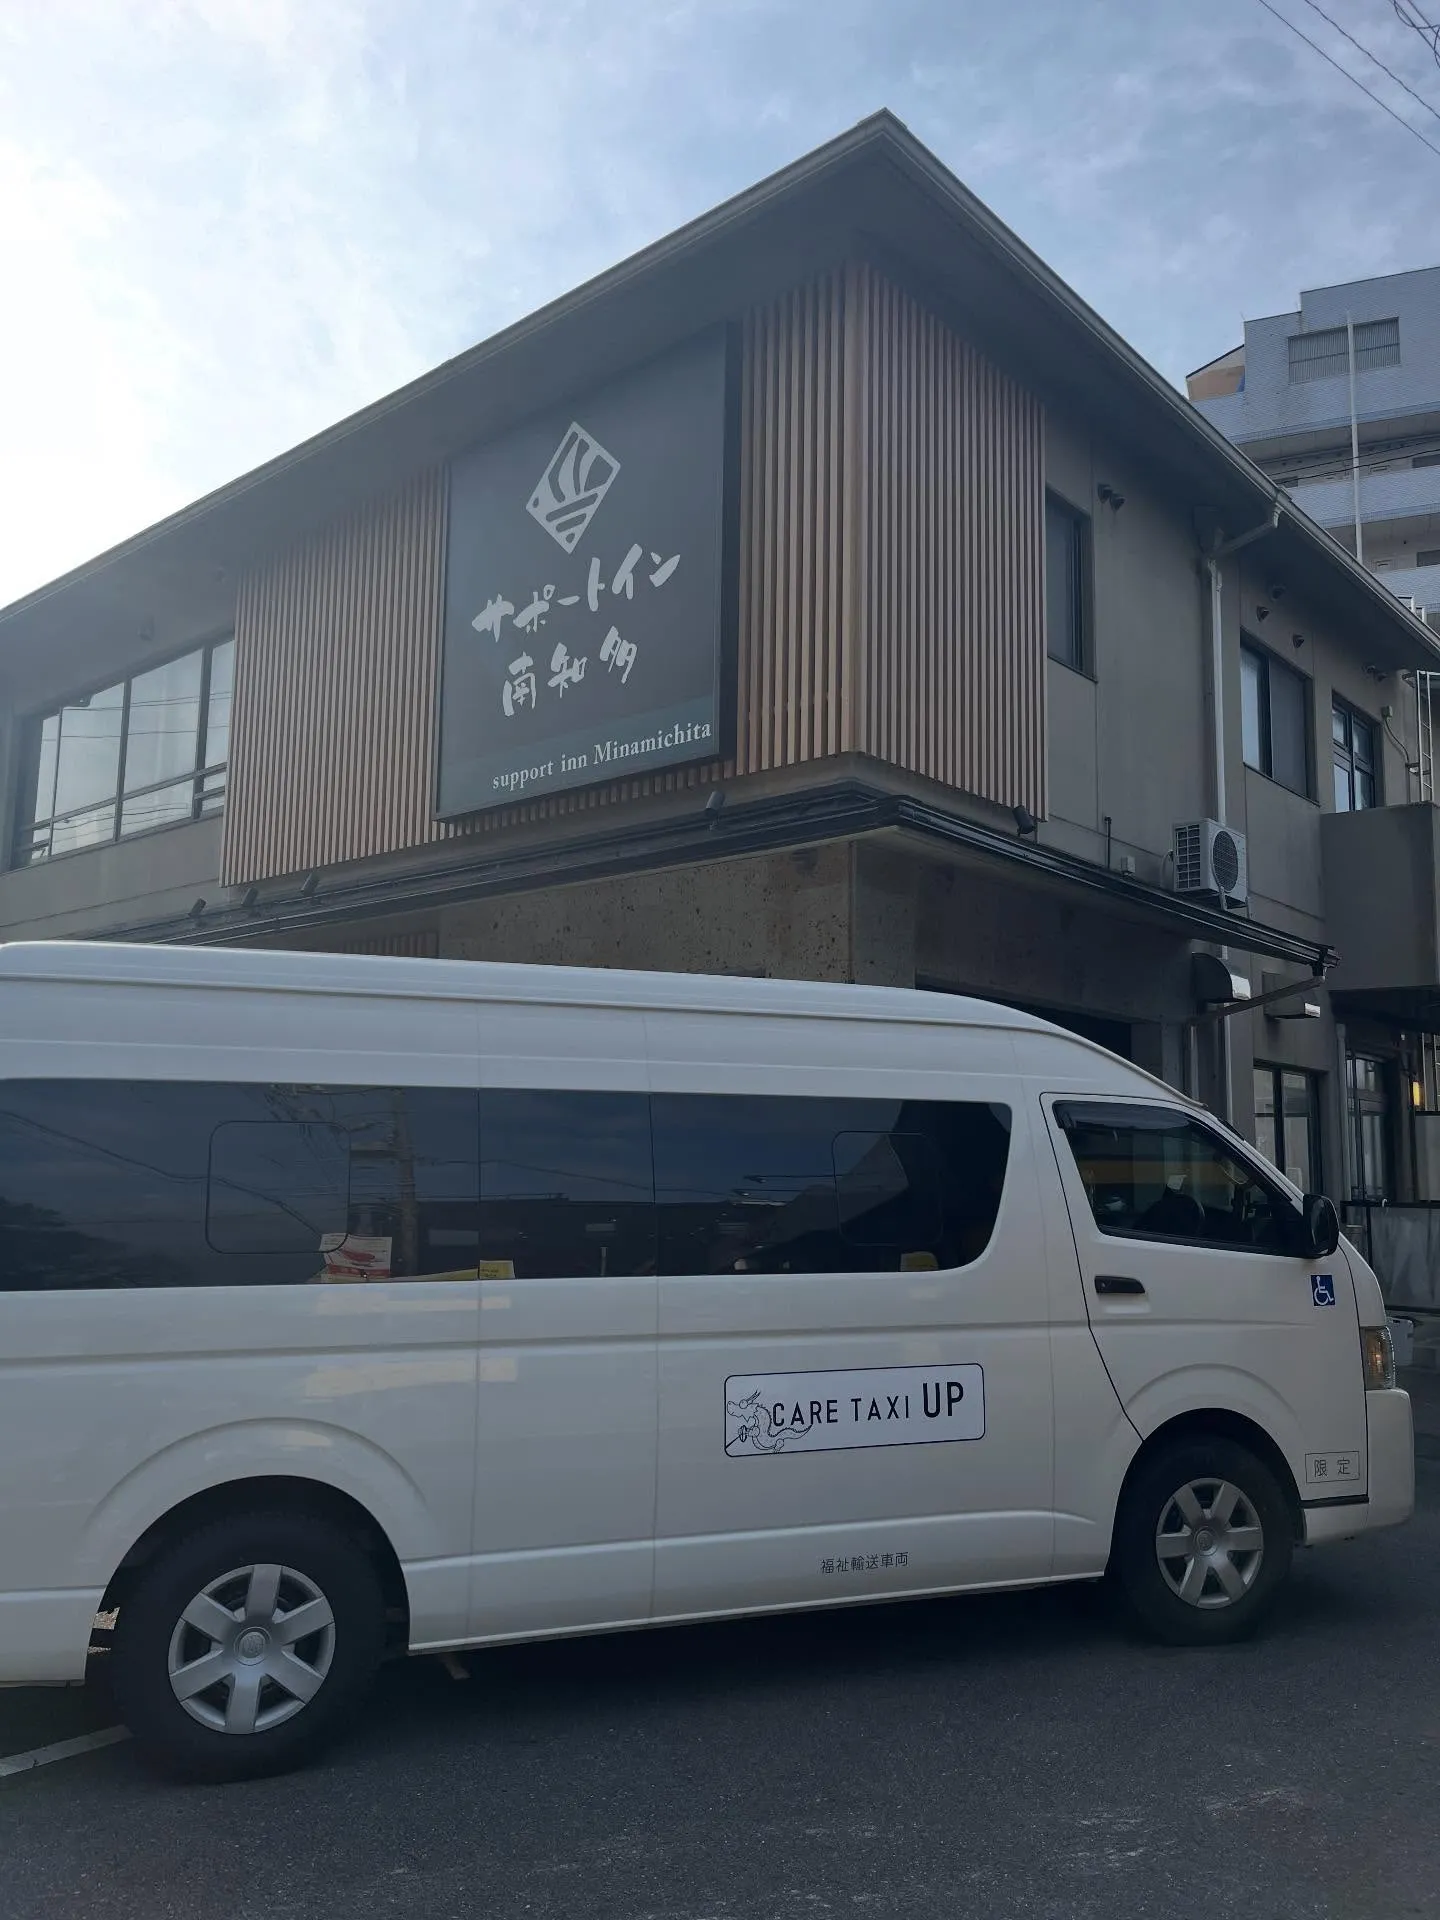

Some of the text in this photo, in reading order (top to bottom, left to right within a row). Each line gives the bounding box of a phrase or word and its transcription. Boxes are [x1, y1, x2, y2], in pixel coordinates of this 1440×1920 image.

[472, 544, 681, 643] サポートイン
[502, 625, 637, 717] 南知多
[492, 722, 712, 792] support inn Minamichita
[772, 1381, 964, 1427] CARE TAXI UP
[1314, 1458, 1350, 1478] 限定
[820, 1552, 909, 1574] 福祉輸送車両
